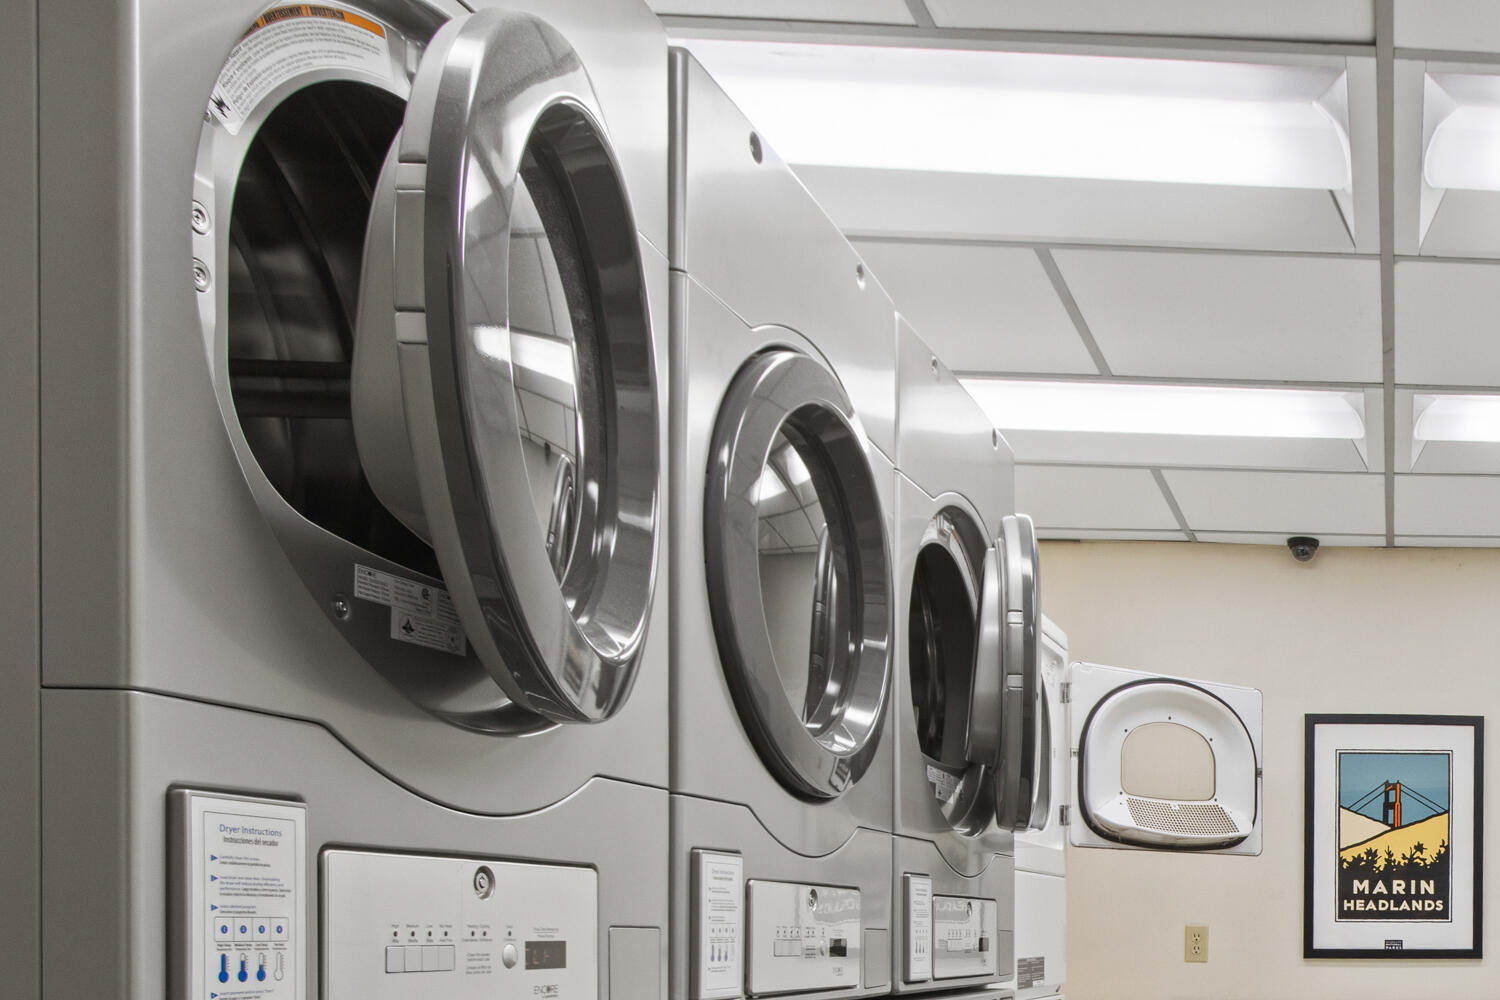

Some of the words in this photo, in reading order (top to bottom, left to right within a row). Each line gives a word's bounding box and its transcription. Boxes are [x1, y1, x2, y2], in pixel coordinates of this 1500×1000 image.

[219, 823, 240, 835] Dryer
[241, 826, 282, 837] Instructions
[1352, 879, 1436, 895] MARIN
[1343, 898, 1444, 912] HEADLANDS
